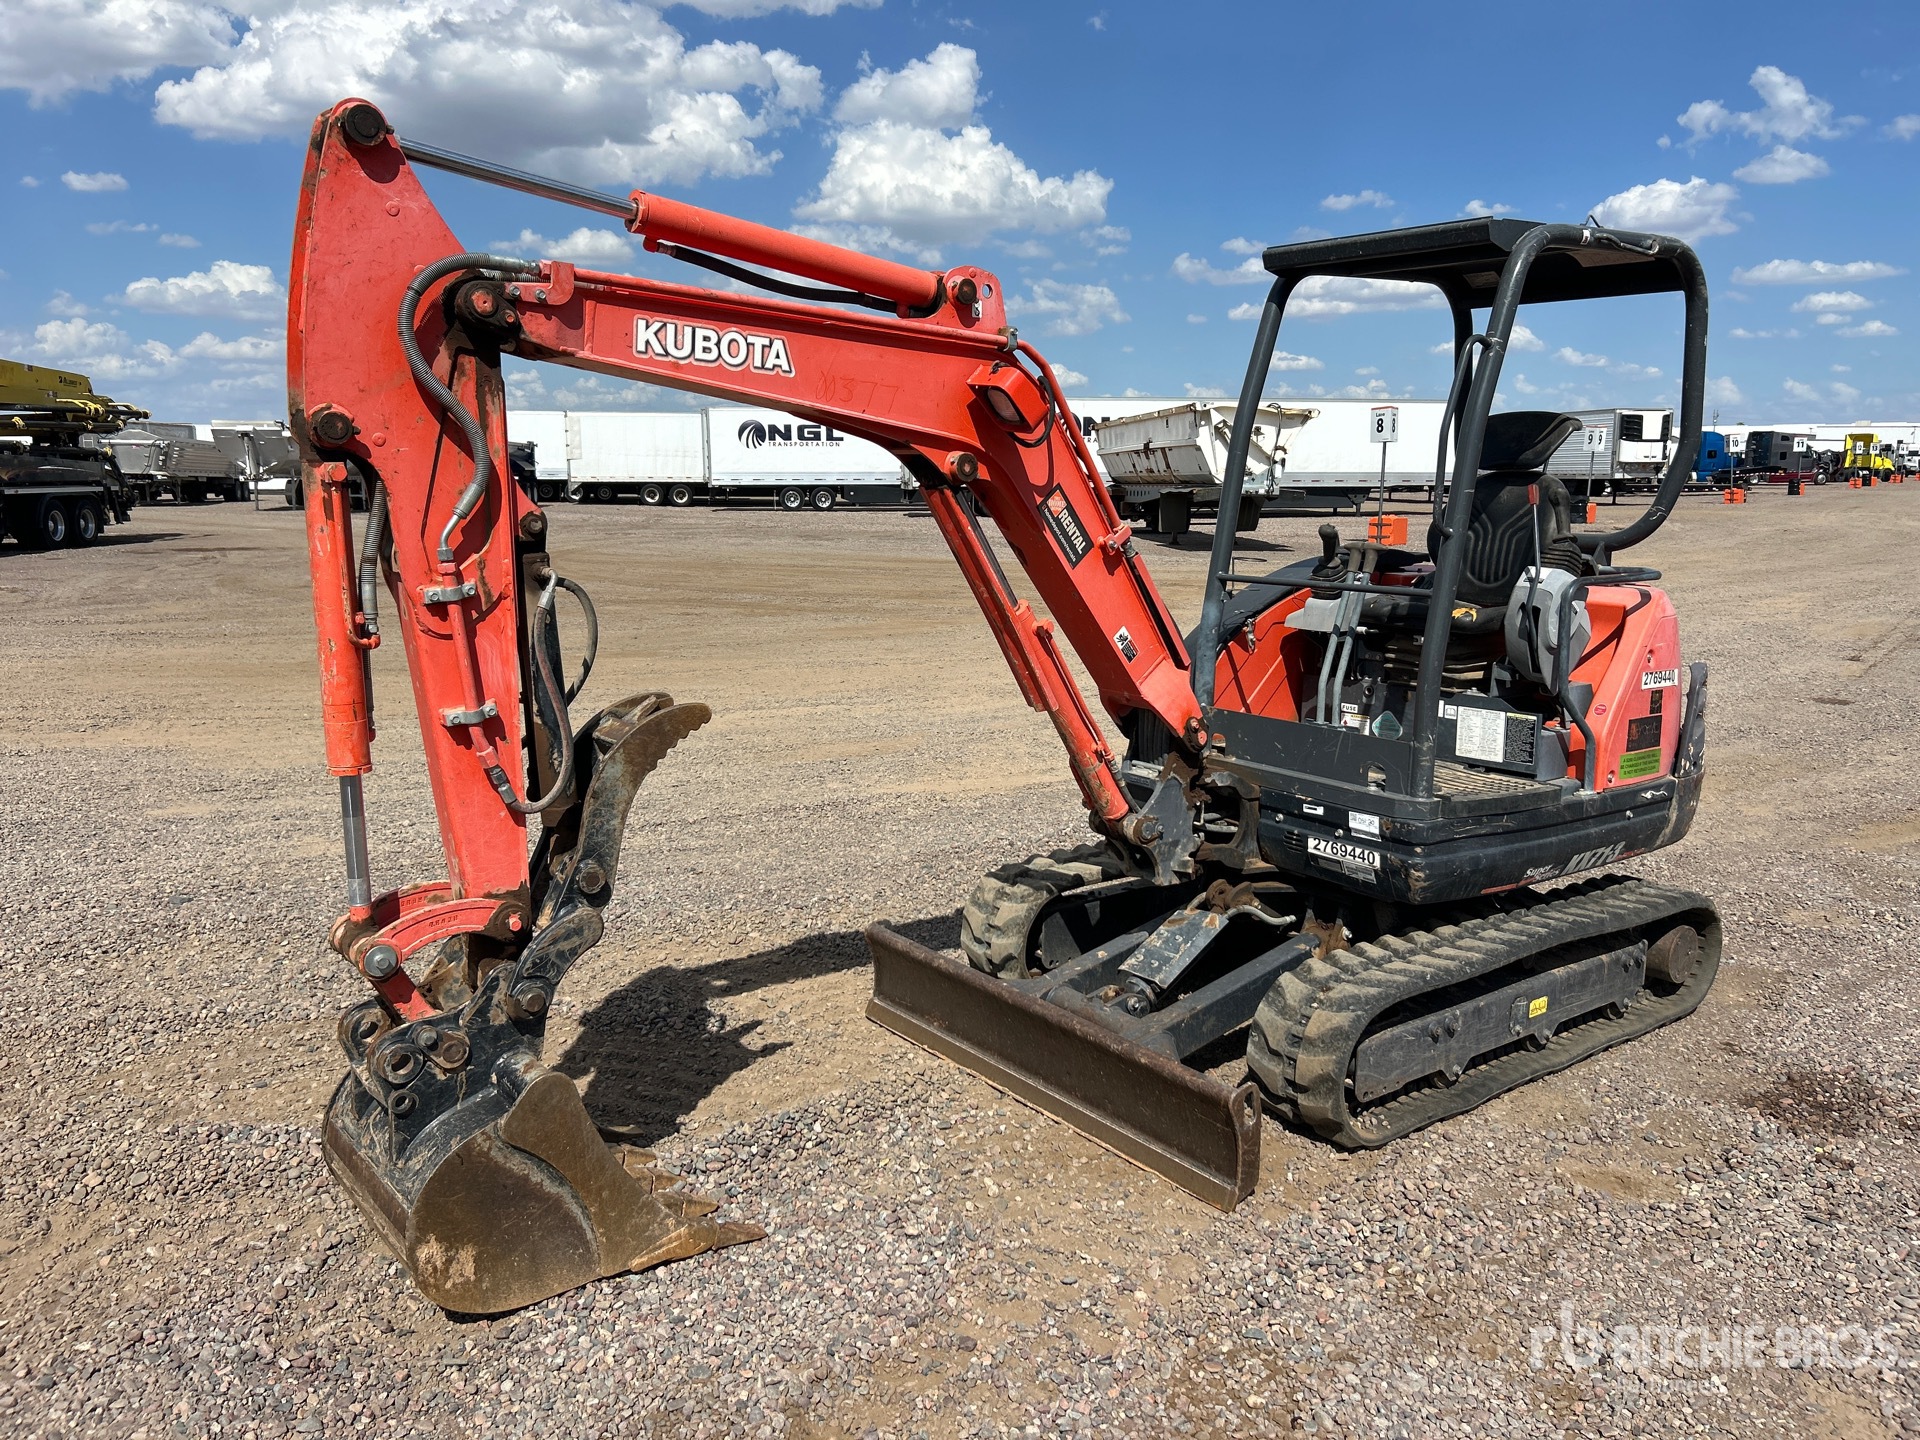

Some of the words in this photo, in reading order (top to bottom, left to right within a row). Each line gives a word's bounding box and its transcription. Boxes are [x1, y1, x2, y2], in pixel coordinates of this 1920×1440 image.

[635, 317, 793, 374] KUBOTA
[767, 424, 844, 441] NGL
[1376, 418, 1384, 433] 8
[1392, 417, 1396, 433] 8
[1587, 433, 1593, 445] 9
[1598, 434, 1602, 445] 9
[1731, 439, 1739, 448] 10
[1058, 508, 1086, 555] RENTAL
[1643, 670, 1676, 686] 2769440
[1342, 704, 1357, 712] FUSE
[1312, 837, 1376, 865] 2769440
[1523, 863, 1555, 878] Super
